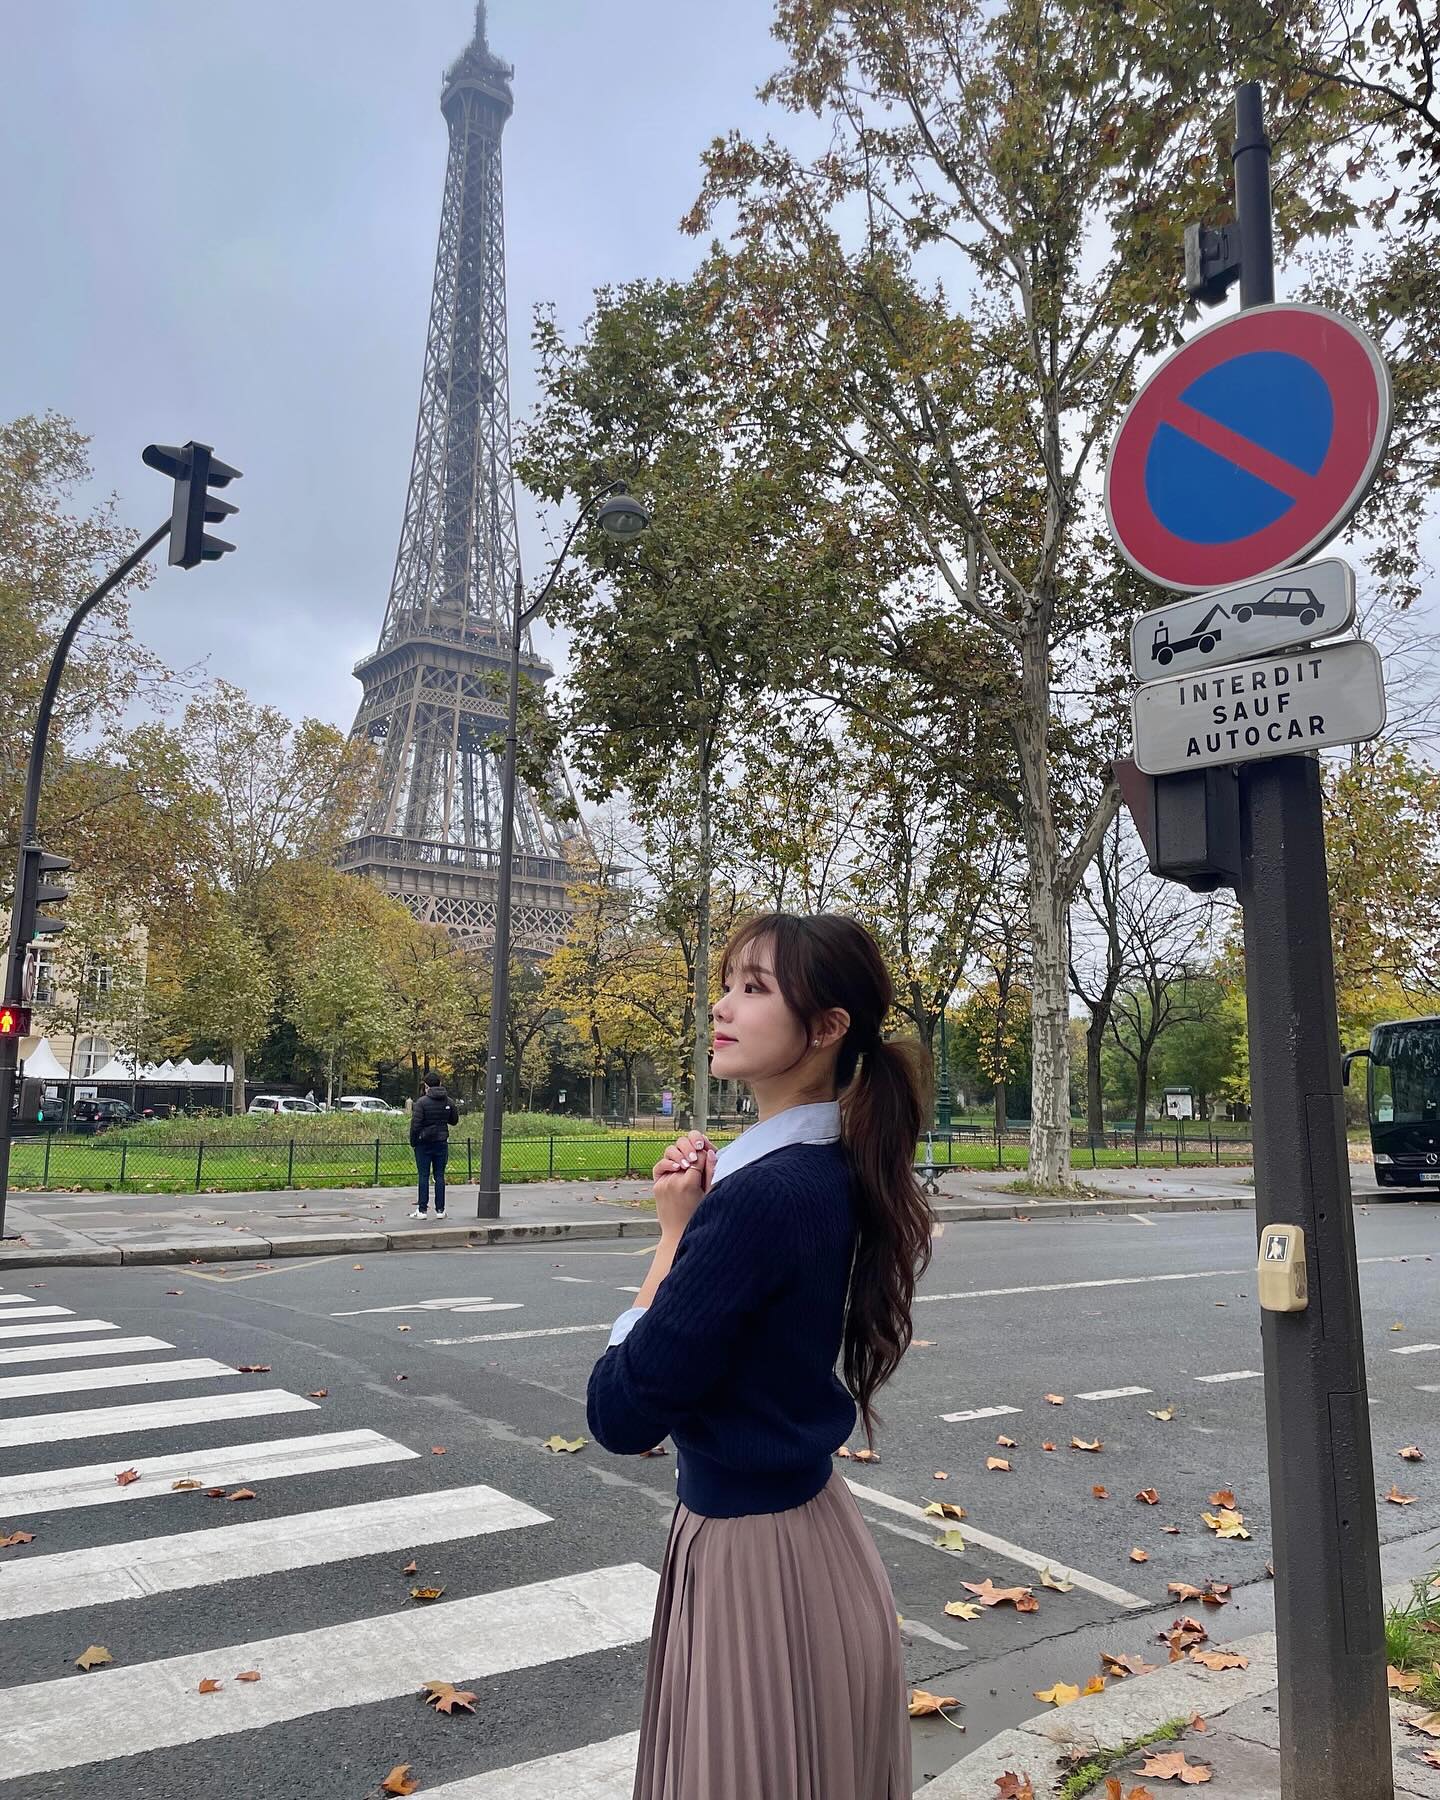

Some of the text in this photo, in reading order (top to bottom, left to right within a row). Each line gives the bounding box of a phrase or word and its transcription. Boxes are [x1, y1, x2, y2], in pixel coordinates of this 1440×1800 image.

[1180, 659, 1323, 706] INTERDIT
[1212, 692, 1291, 725] SAUF
[1186, 715, 1326, 758] AUTOCAR
